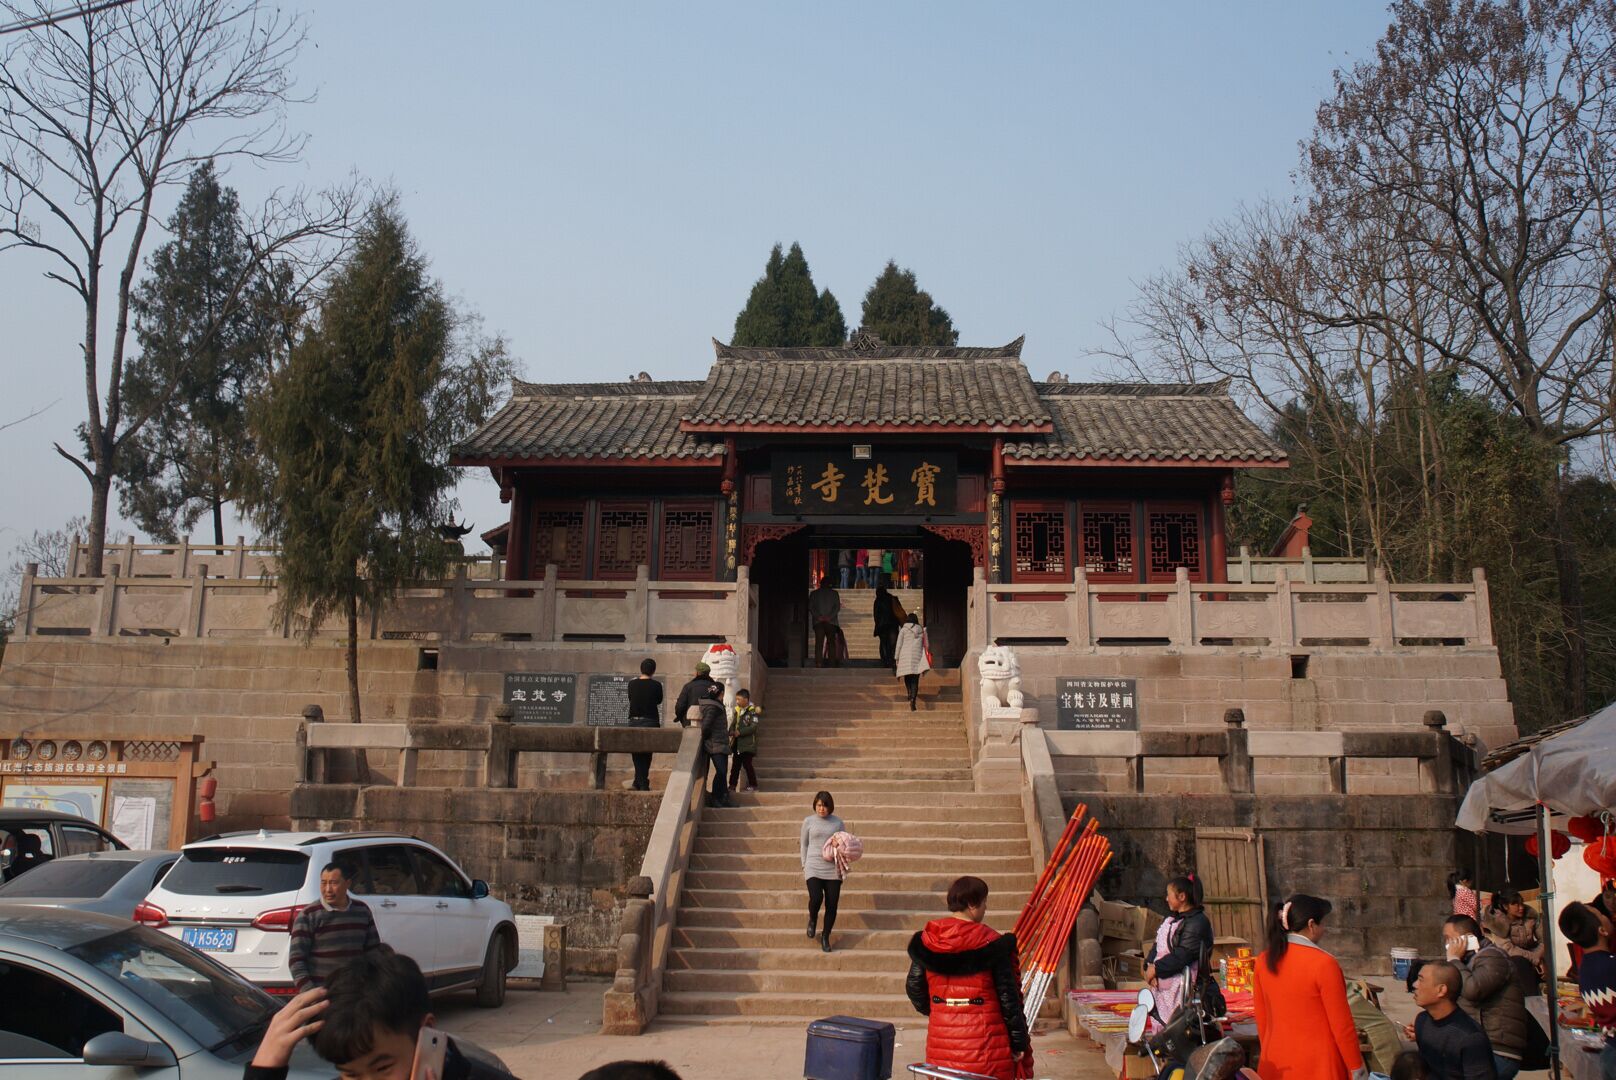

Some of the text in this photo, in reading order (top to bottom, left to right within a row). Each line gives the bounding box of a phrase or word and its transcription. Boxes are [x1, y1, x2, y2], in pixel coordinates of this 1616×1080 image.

[810, 461, 942, 507] 寶梵寺
[507, 676, 573, 684] 全国重点文物保护单位
[511, 689, 567, 702] 宝梵寺
[1061, 692, 1133, 709] 宝梵寺及壁画
